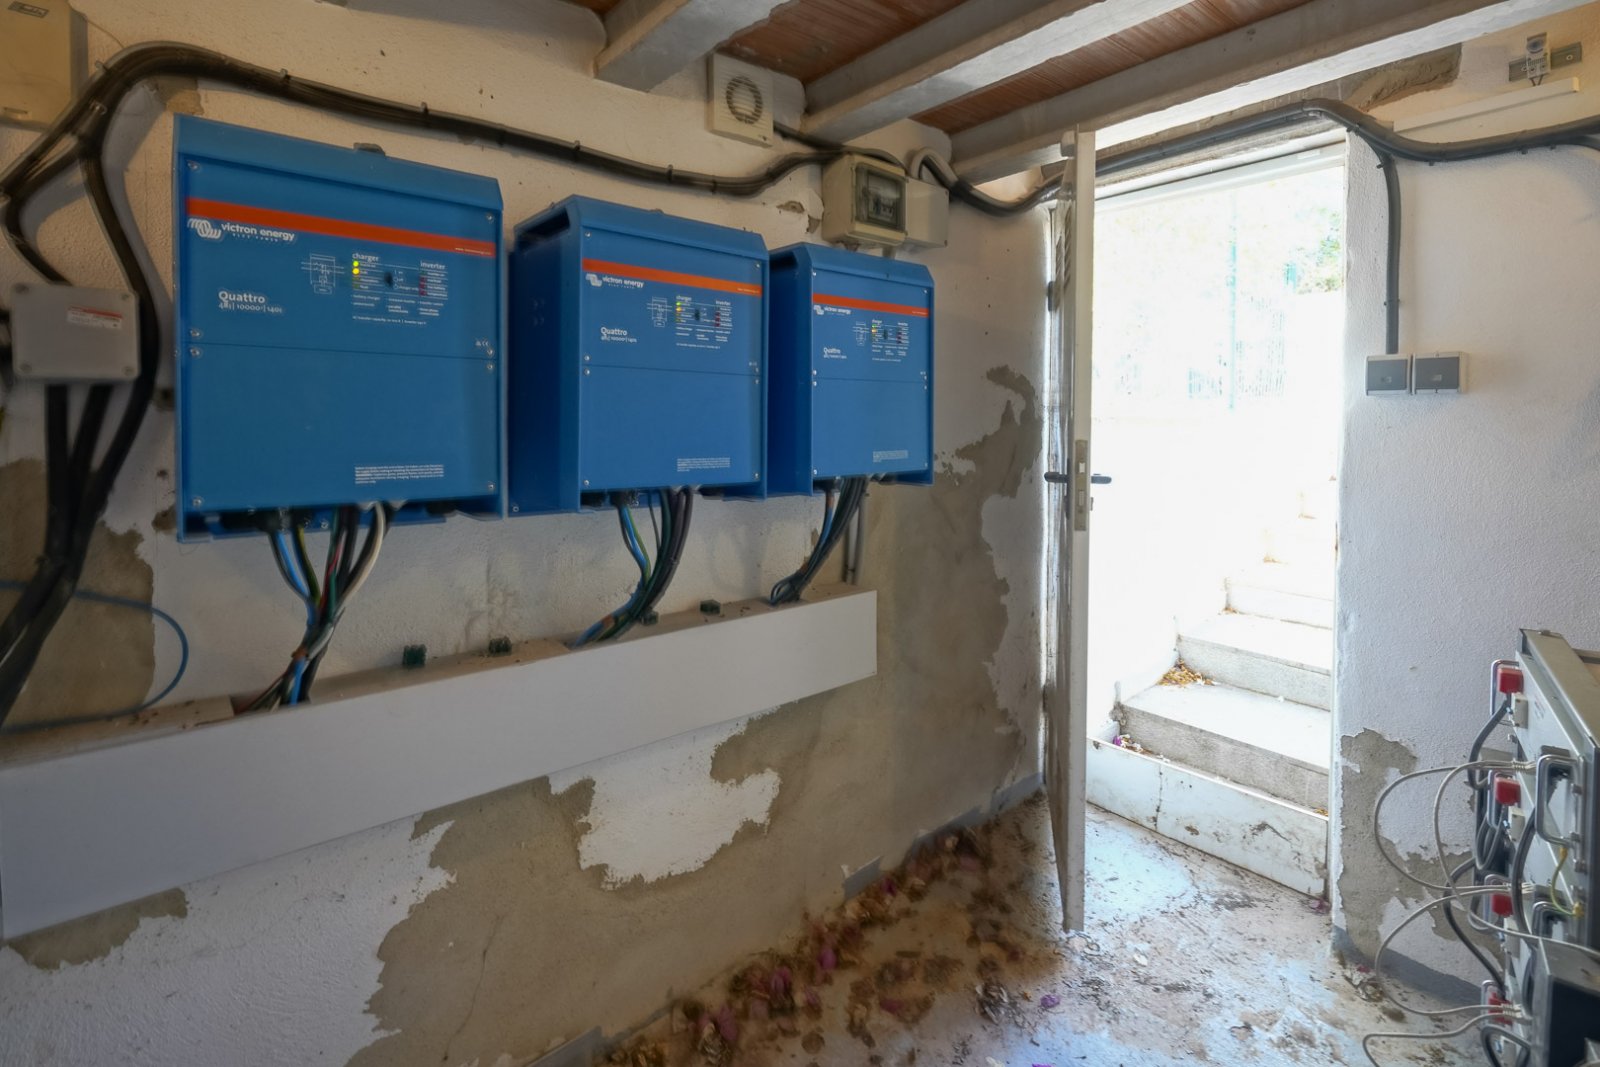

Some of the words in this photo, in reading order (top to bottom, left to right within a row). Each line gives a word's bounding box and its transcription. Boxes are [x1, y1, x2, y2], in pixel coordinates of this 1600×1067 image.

[221, 222, 257, 235] victron
[259, 229, 295, 241] energy
[352, 253, 379, 262] charger
[420, 261, 446, 270] inverter
[602, 275, 623, 284] victron
[624, 279, 644, 288] energy
[218, 291, 265, 303] Quattro
[600, 327, 628, 336] Quattro
